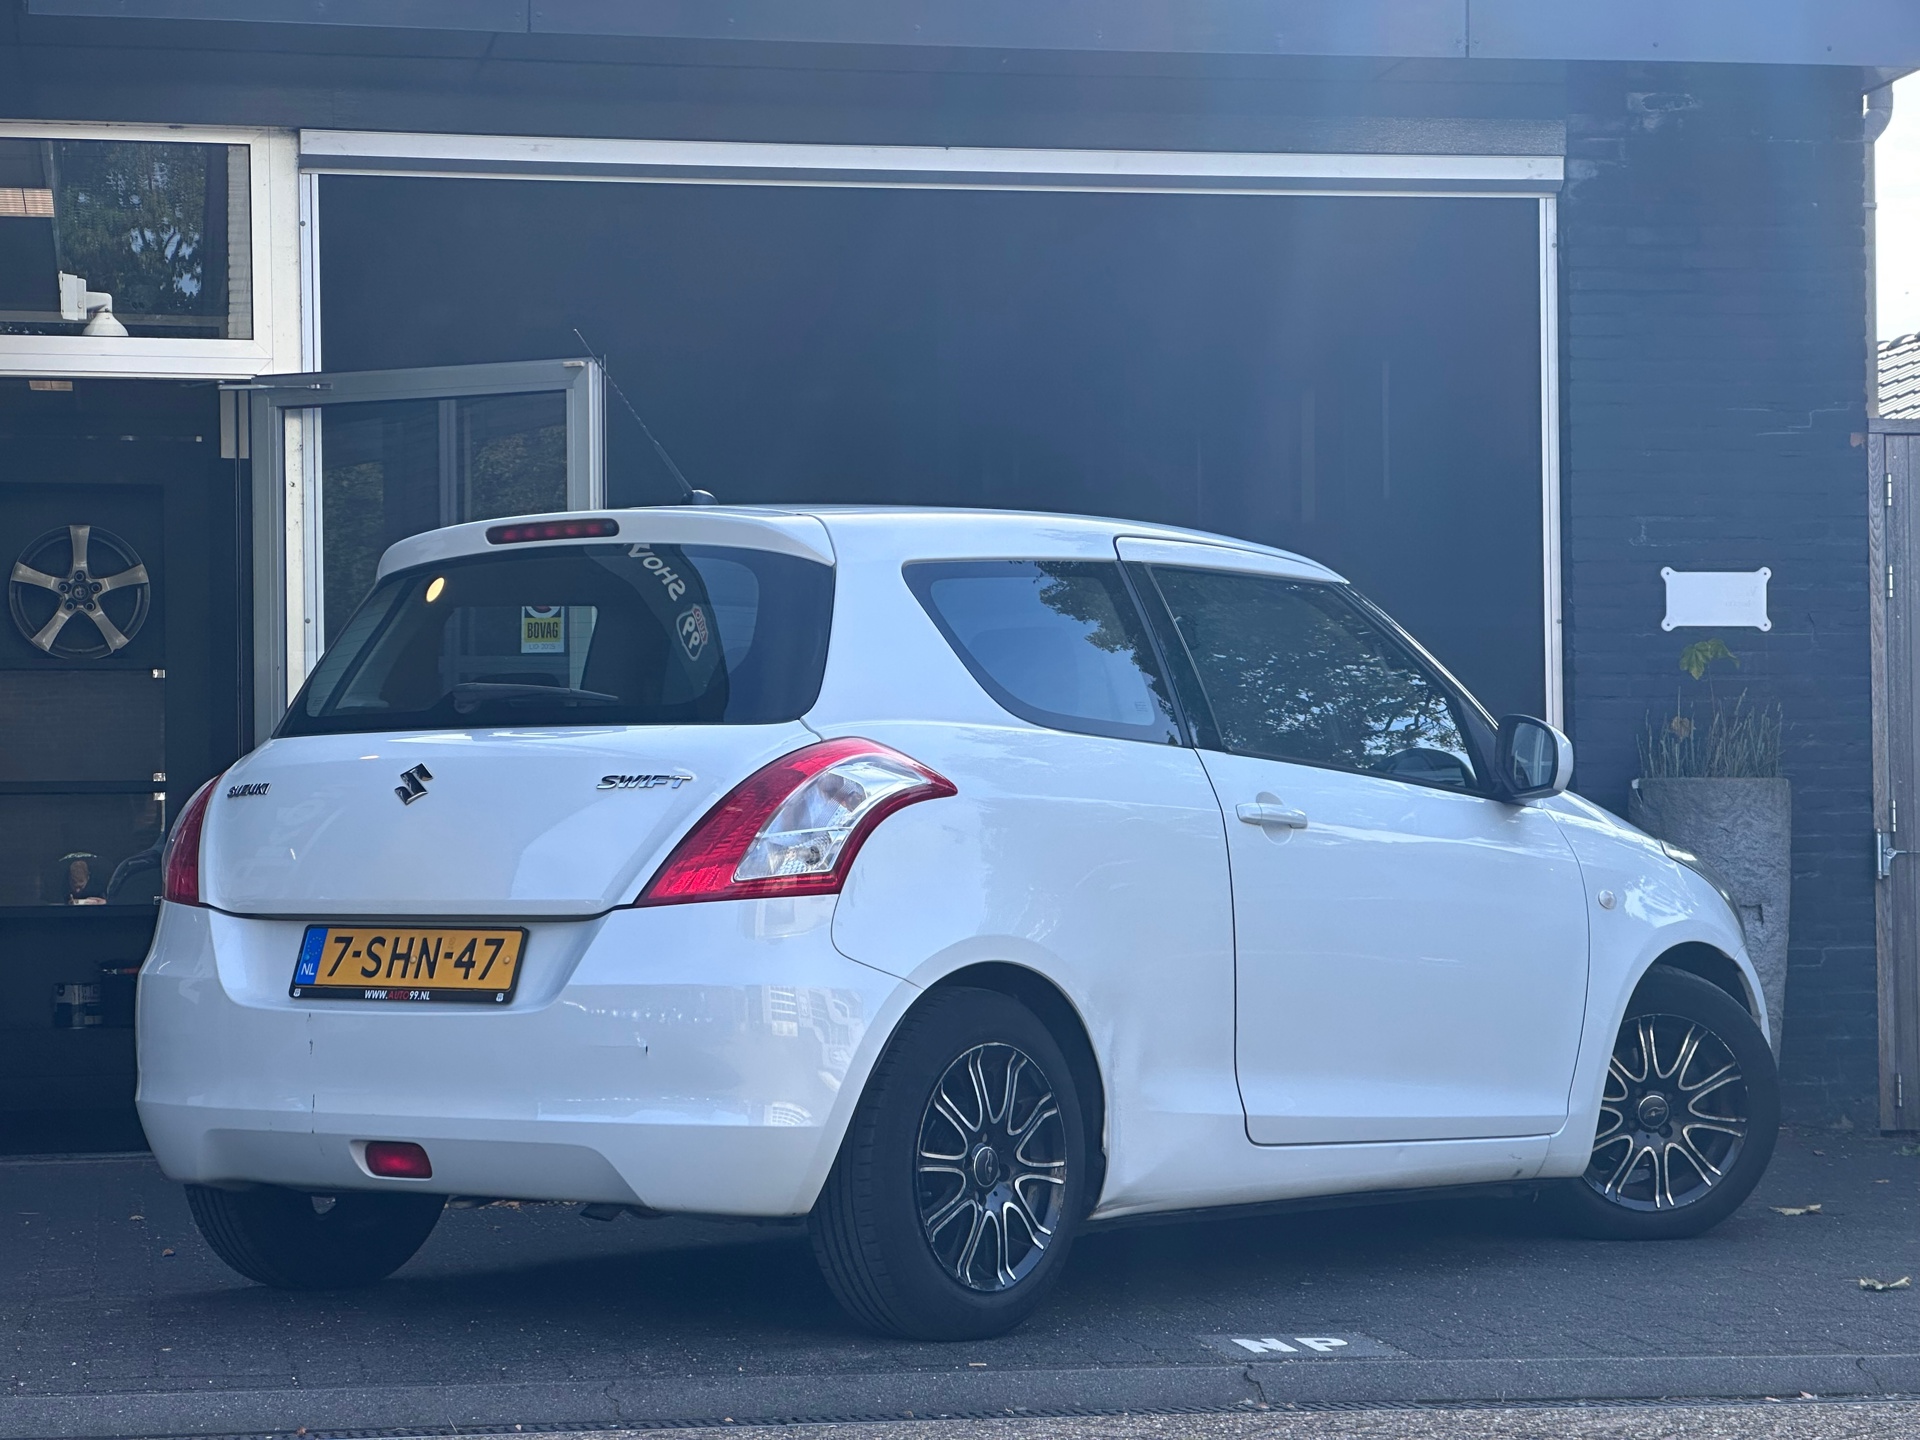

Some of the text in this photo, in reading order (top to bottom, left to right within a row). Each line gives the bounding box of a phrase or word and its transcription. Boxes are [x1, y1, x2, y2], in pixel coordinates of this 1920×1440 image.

[527, 622, 559, 639] BOVAG
[596, 774, 693, 790] SWIFT
[227, 782, 271, 799] SUZUKI
[327, 936, 505, 980] 7-SHN-47
[300, 962, 315, 975] NL
[364, 989, 430, 1001] WWW.AUTO99.NL
